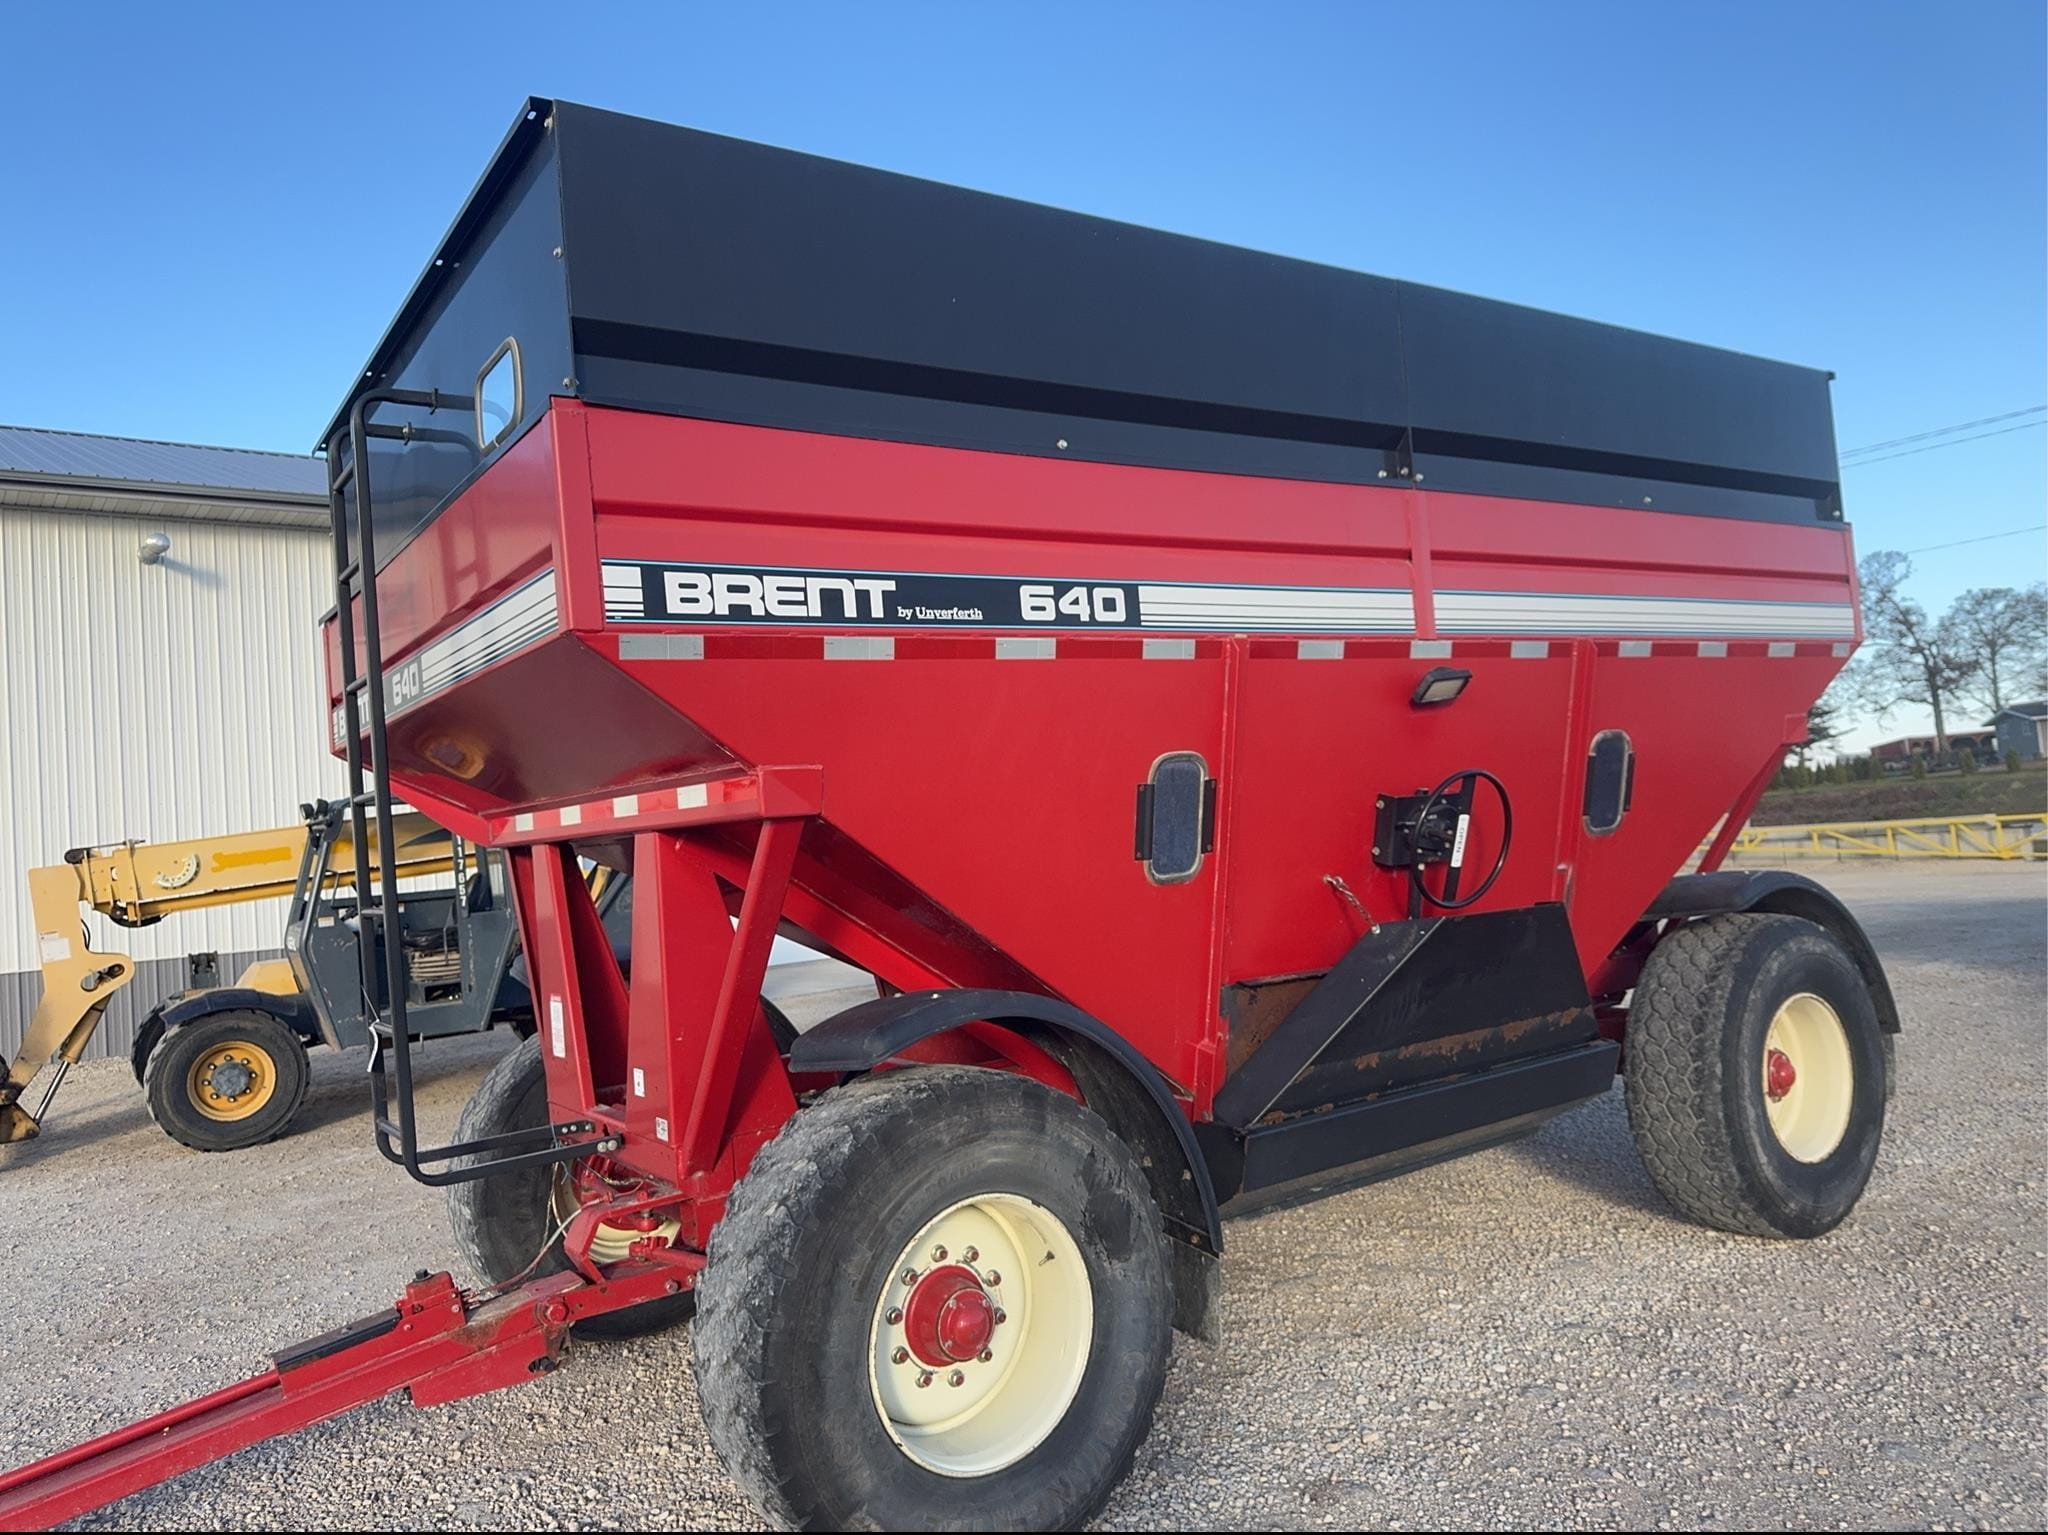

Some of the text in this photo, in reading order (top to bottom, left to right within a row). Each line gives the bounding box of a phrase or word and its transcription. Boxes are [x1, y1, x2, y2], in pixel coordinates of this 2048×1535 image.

[664, 571, 896, 619] BRENT
[897, 606, 983, 620] by Unverferth
[1019, 584, 1126, 622] 640
[392, 662, 419, 706] 640
